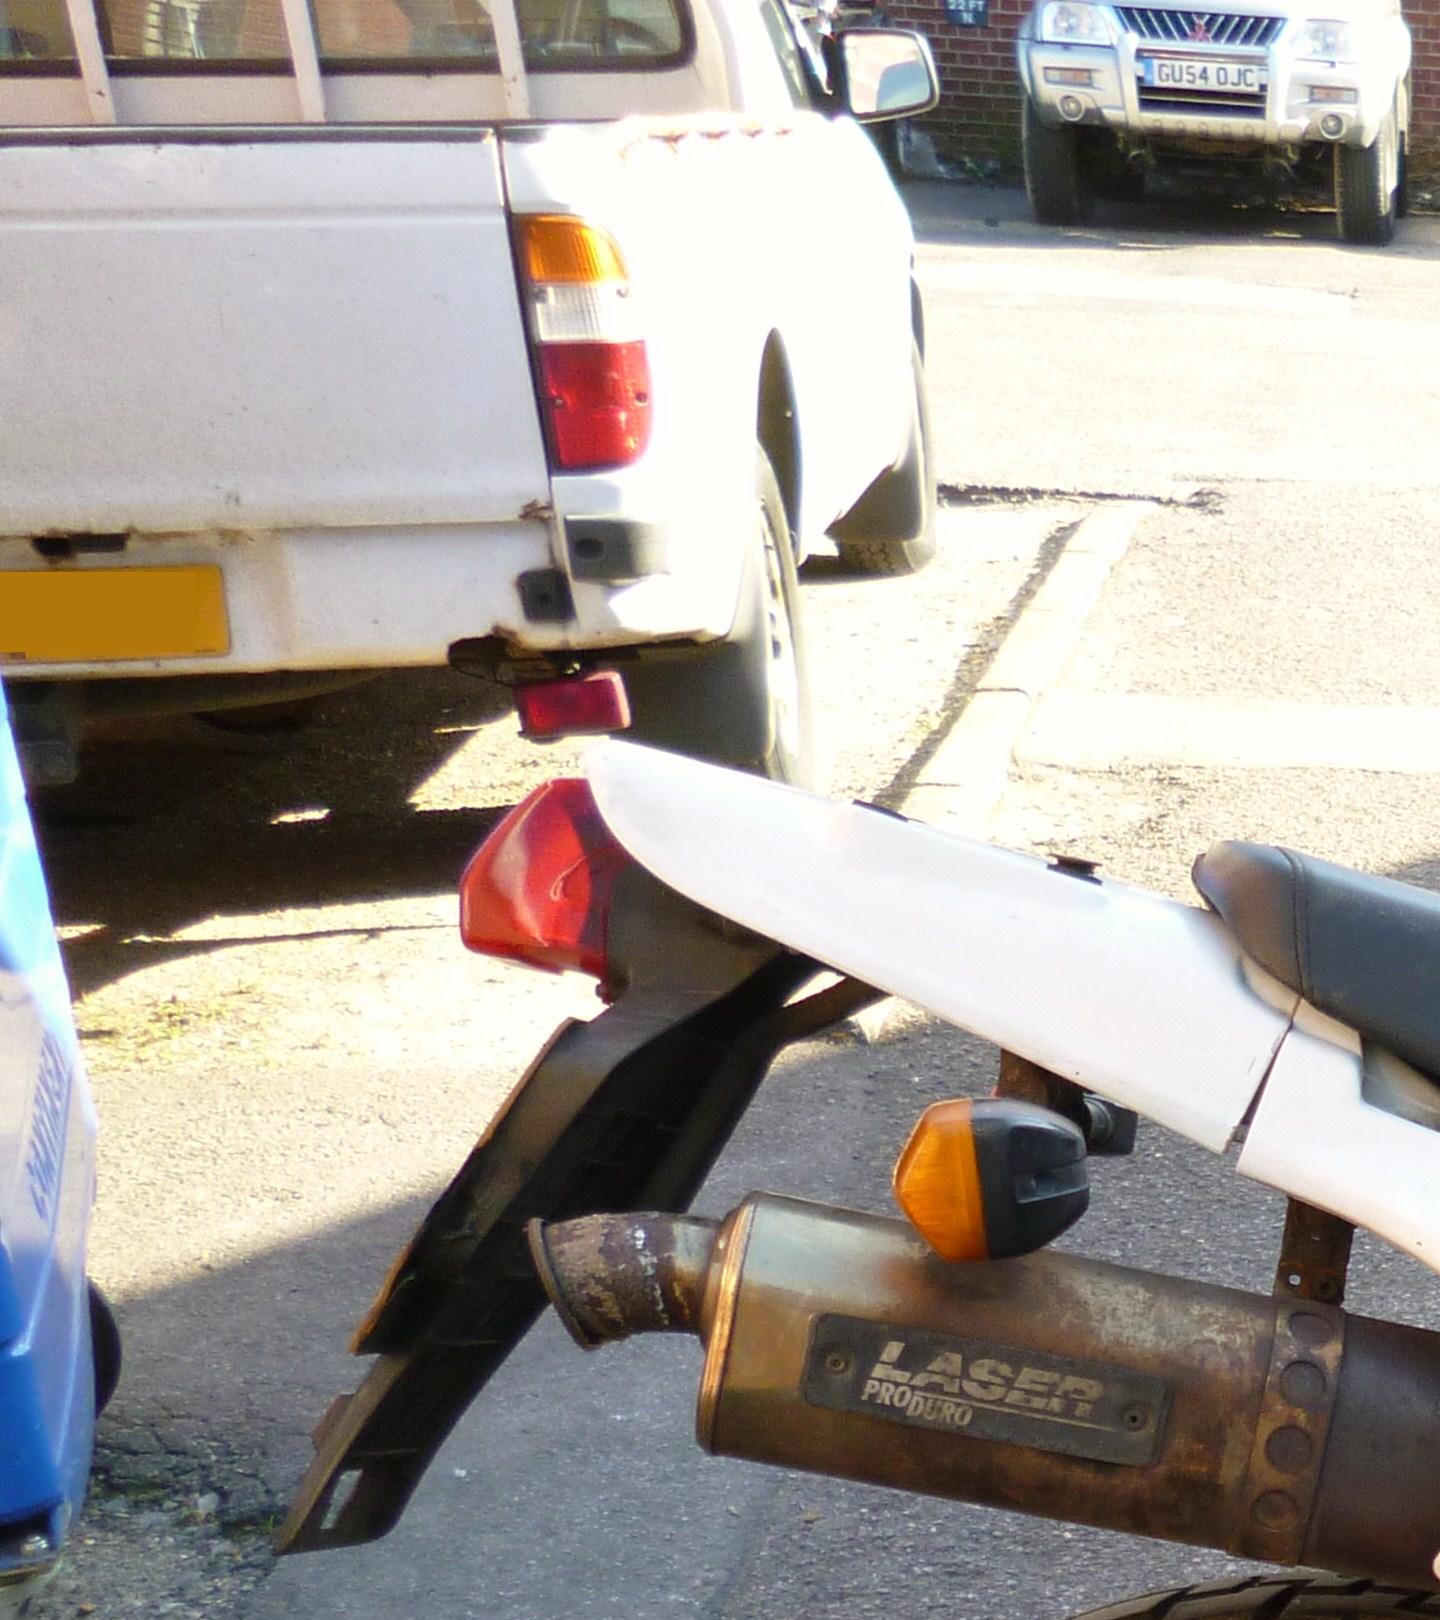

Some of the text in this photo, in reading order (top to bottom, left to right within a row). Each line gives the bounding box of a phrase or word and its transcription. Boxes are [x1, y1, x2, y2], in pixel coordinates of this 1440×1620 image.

[1158, 63, 1254, 87] GU54 OJC
[870, 1340, 1105, 1417] LASER
